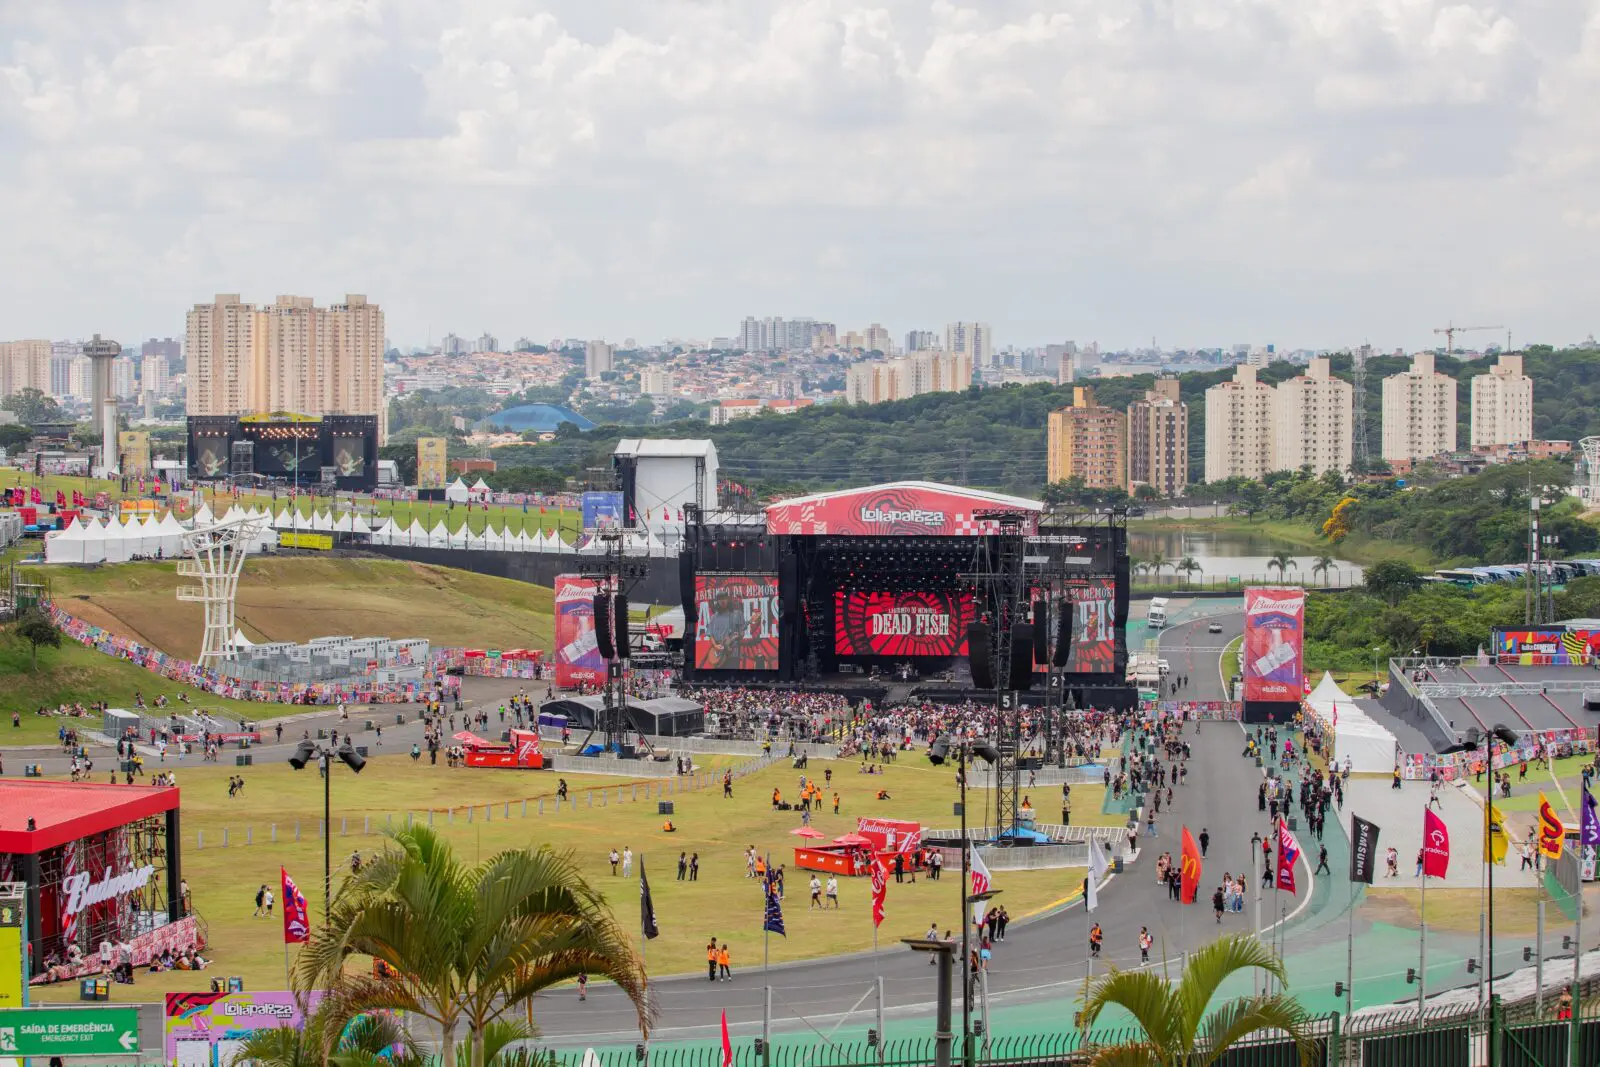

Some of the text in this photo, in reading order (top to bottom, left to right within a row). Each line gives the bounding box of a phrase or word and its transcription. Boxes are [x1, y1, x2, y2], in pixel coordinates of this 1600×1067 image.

[861, 506, 945, 523] Lollapalooza
[872, 613, 950, 635] DEAD FISH
[1052, 676, 1058, 687] 2
[1002, 695, 1011, 708] 5
[859, 819, 898, 834] Budweiser
[1356, 823, 1369, 876] SAMSUNG
[62, 863, 155, 915] Budweiser
[224, 1002, 293, 1017] Lollapalooza
[20, 1022, 114, 1034] SAÍDA DE EMERGÊNCIA
[41, 1033, 94, 1042] EMERGENCY EXIT
